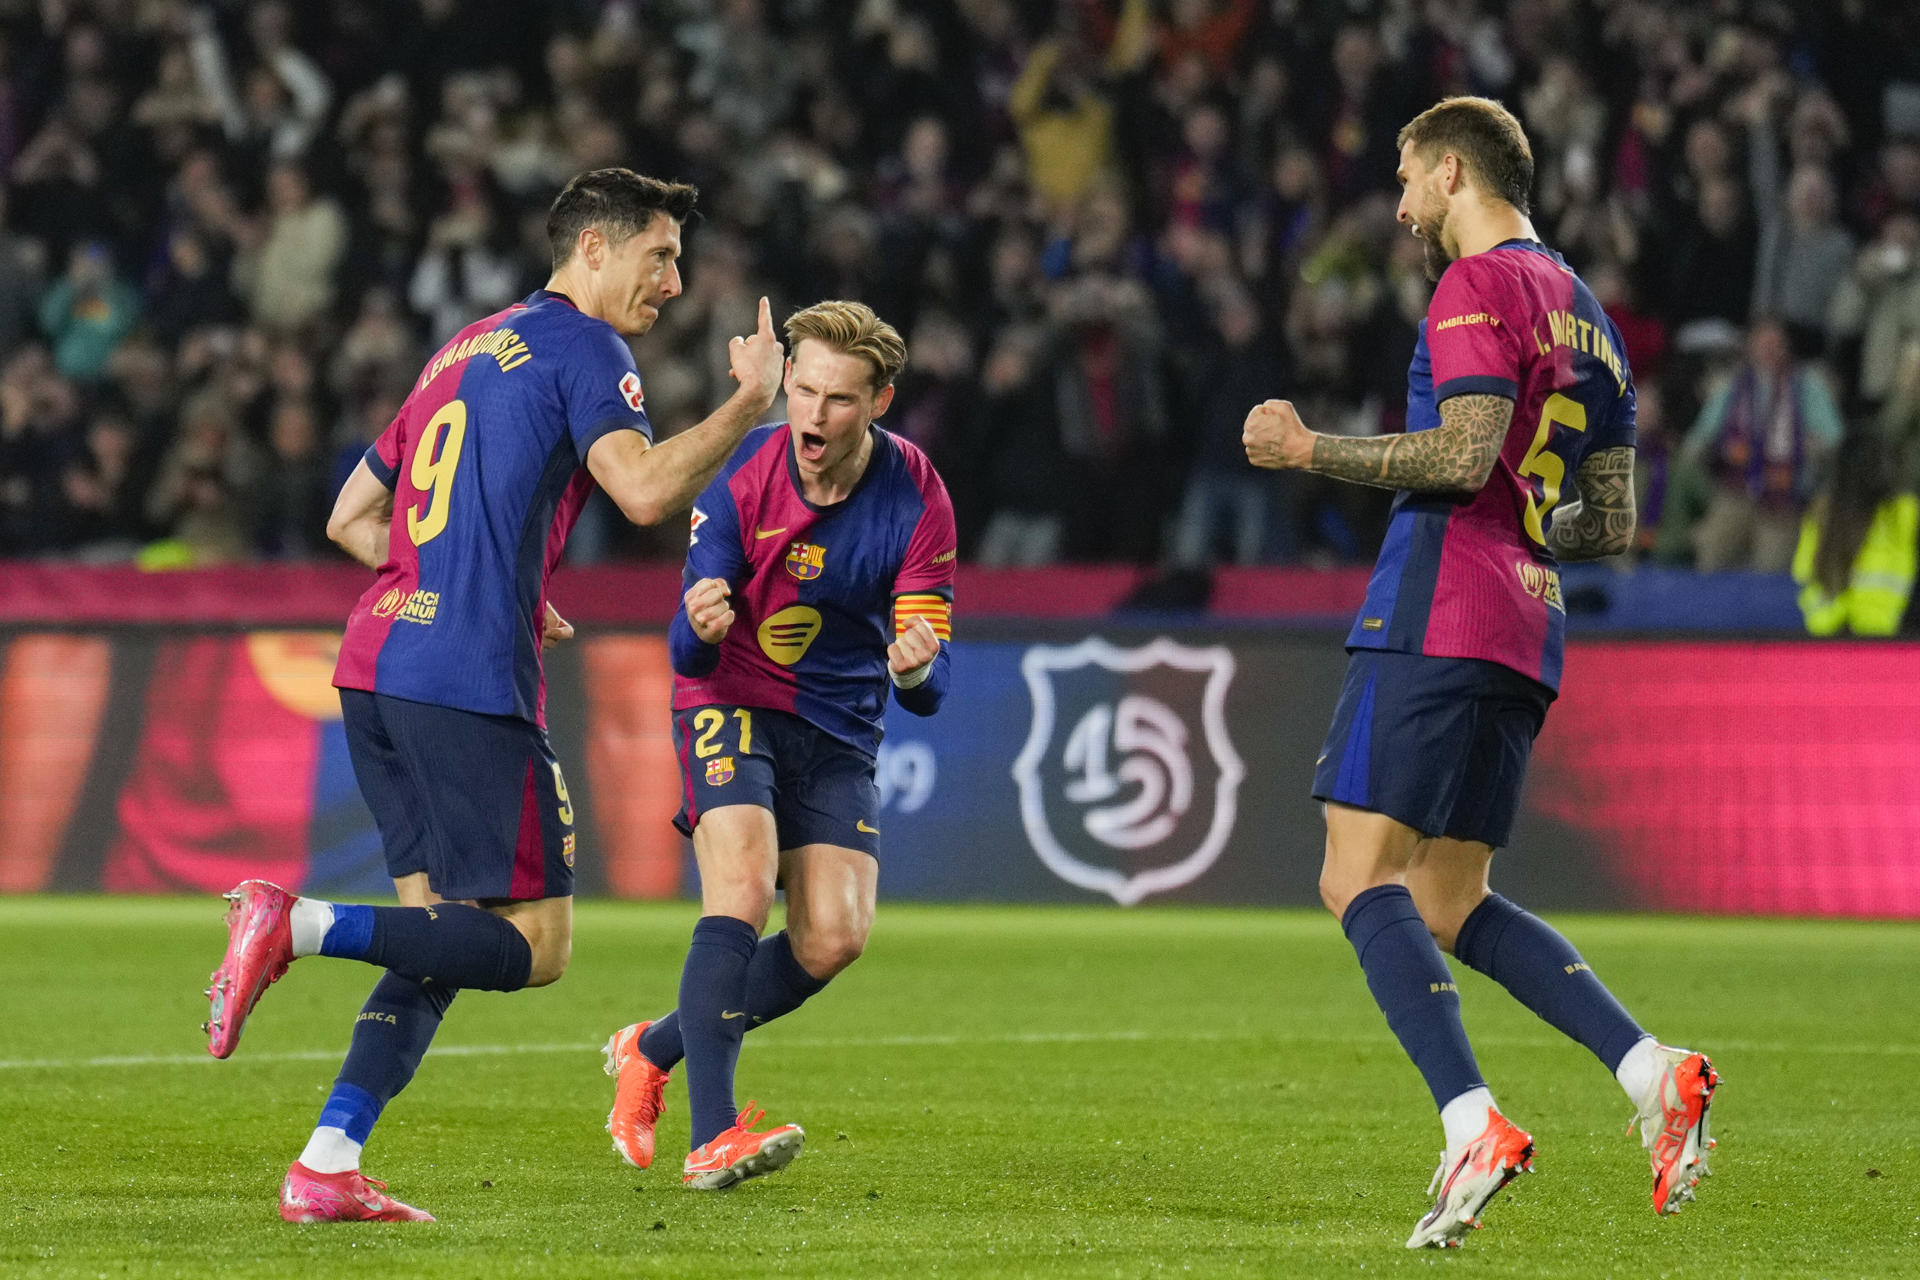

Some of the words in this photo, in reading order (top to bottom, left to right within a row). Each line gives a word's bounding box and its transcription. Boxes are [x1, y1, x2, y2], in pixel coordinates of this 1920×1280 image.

[1436, 312, 1488, 331] AMBILIGHT
[421, 328, 532, 391] LEWANDOWSKI
[407, 399, 466, 547] 9
[1518, 392, 1587, 546] 5
[694, 708, 752, 758] 21
[552, 762, 574, 826] 9
